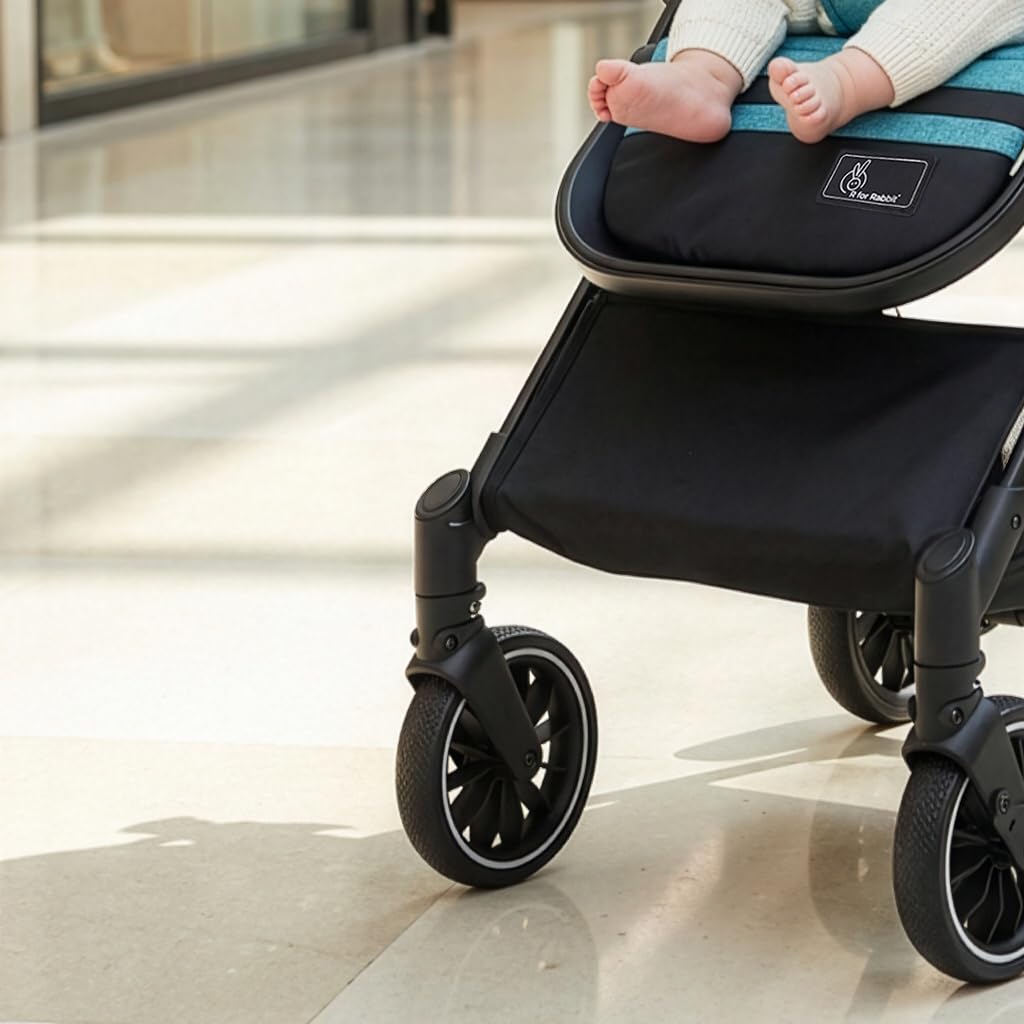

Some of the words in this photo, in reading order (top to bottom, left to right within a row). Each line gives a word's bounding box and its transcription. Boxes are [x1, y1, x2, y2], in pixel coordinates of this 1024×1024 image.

[848, 190, 857, 198] R
[857, 190, 870, 200] for
[869, 192, 898, 203] Rabbit
